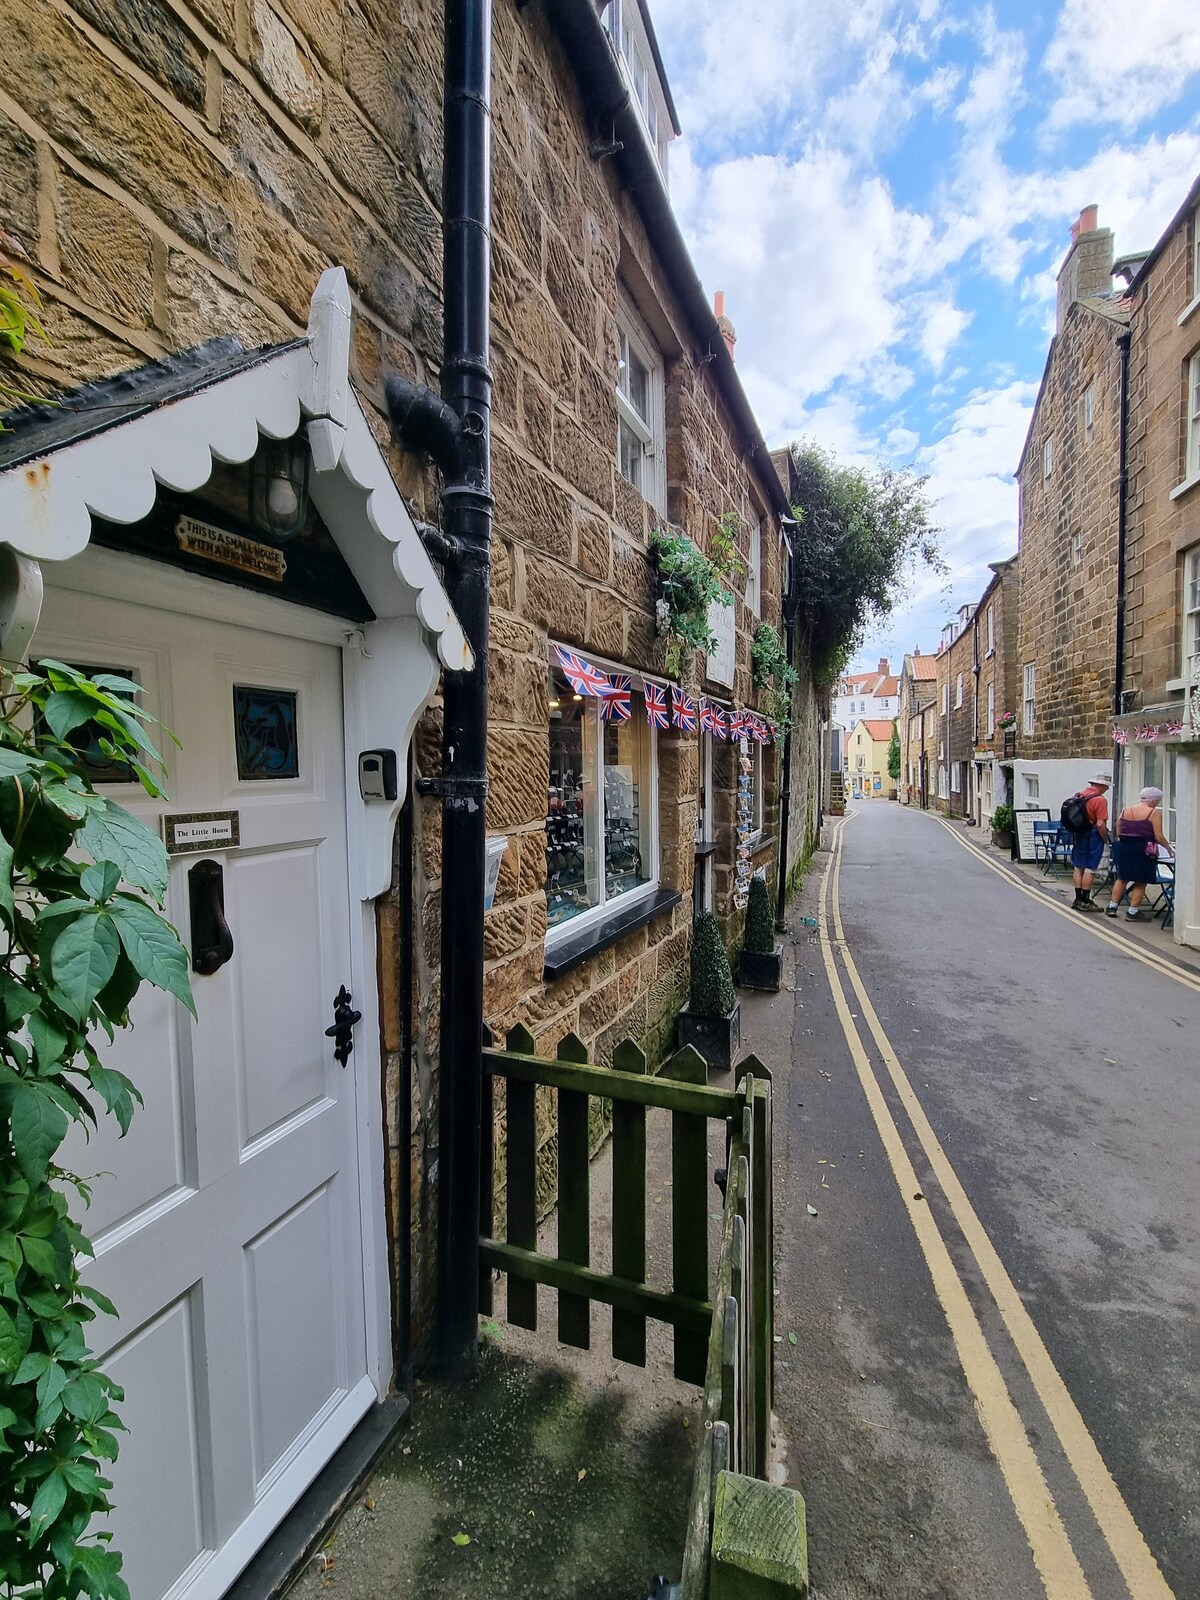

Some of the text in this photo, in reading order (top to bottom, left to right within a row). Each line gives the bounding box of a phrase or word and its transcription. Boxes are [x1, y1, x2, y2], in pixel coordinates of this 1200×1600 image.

[187, 521, 280, 562] THIS IS A SMALL HOUSE
[187, 536, 280, 574] WITH A BIG WELCOME
[192, 828, 209, 836] Little
